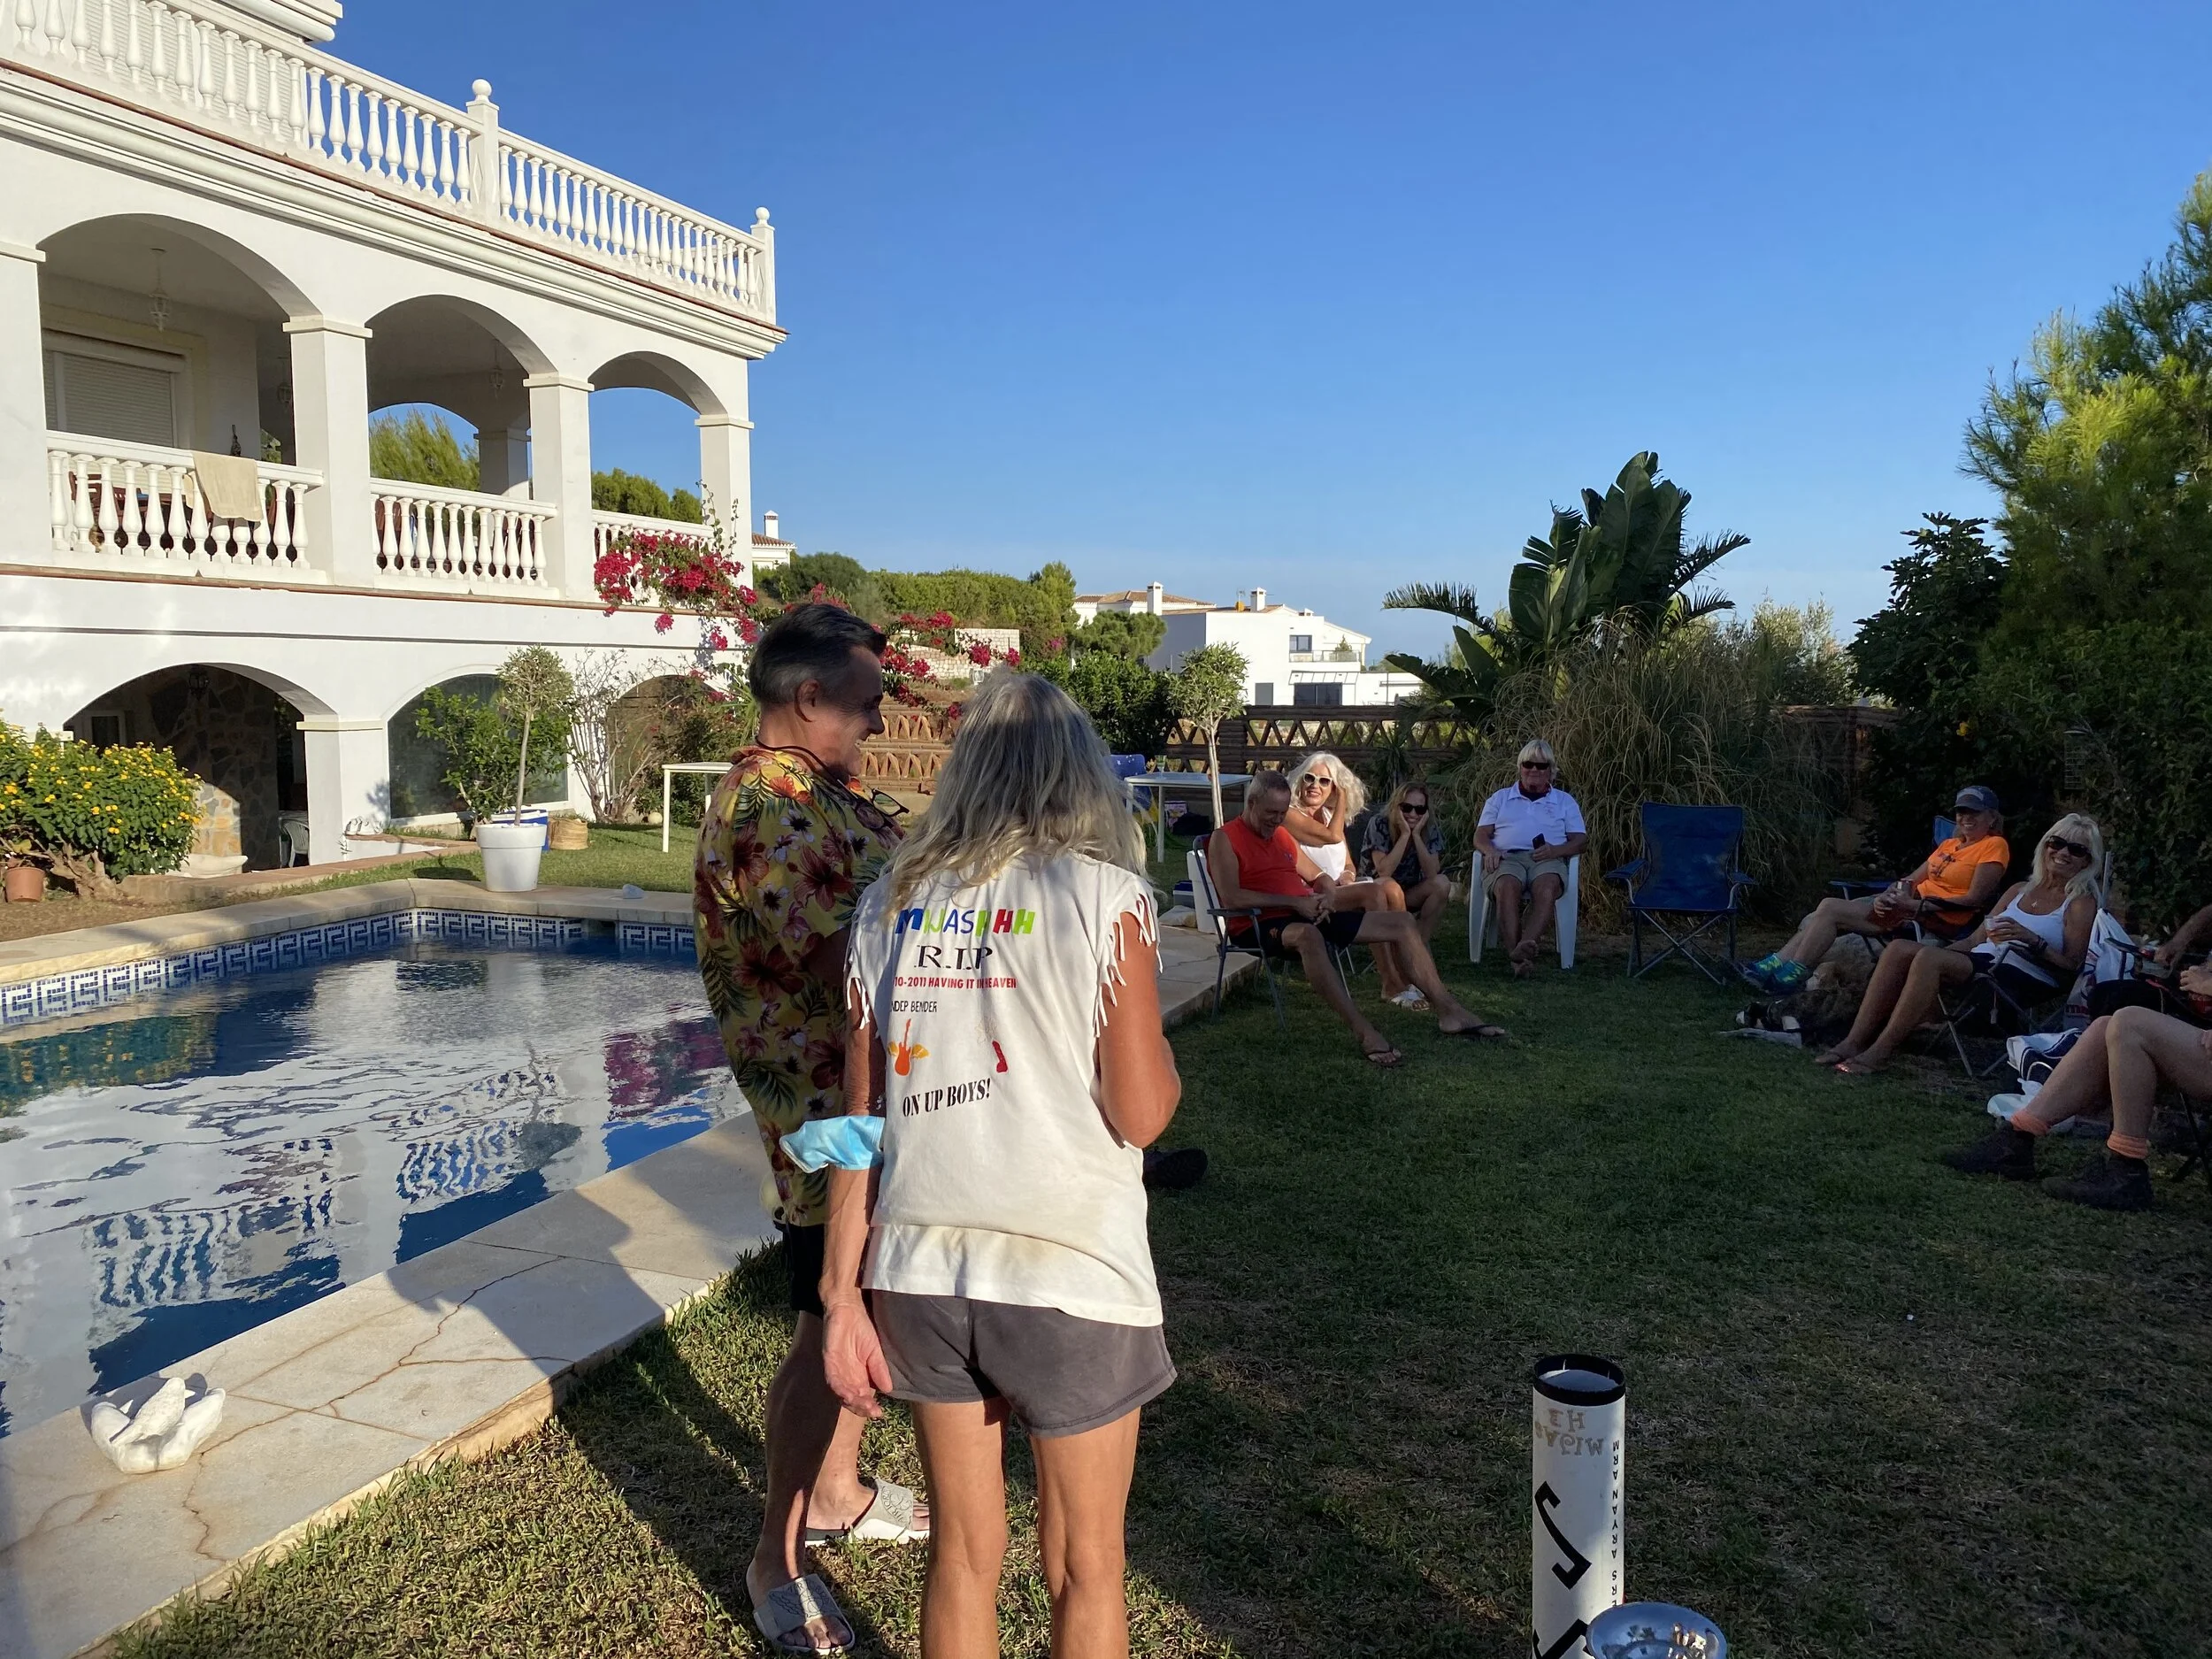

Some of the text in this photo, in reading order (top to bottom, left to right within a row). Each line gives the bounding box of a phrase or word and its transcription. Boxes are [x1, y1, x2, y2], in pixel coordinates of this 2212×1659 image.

[928, 977, 964, 989] HAVING
[966, 979, 975, 989] IT
[910, 1001, 938, 1013] BENDER
[902, 1078, 991, 1118] ON UP BOYS!
